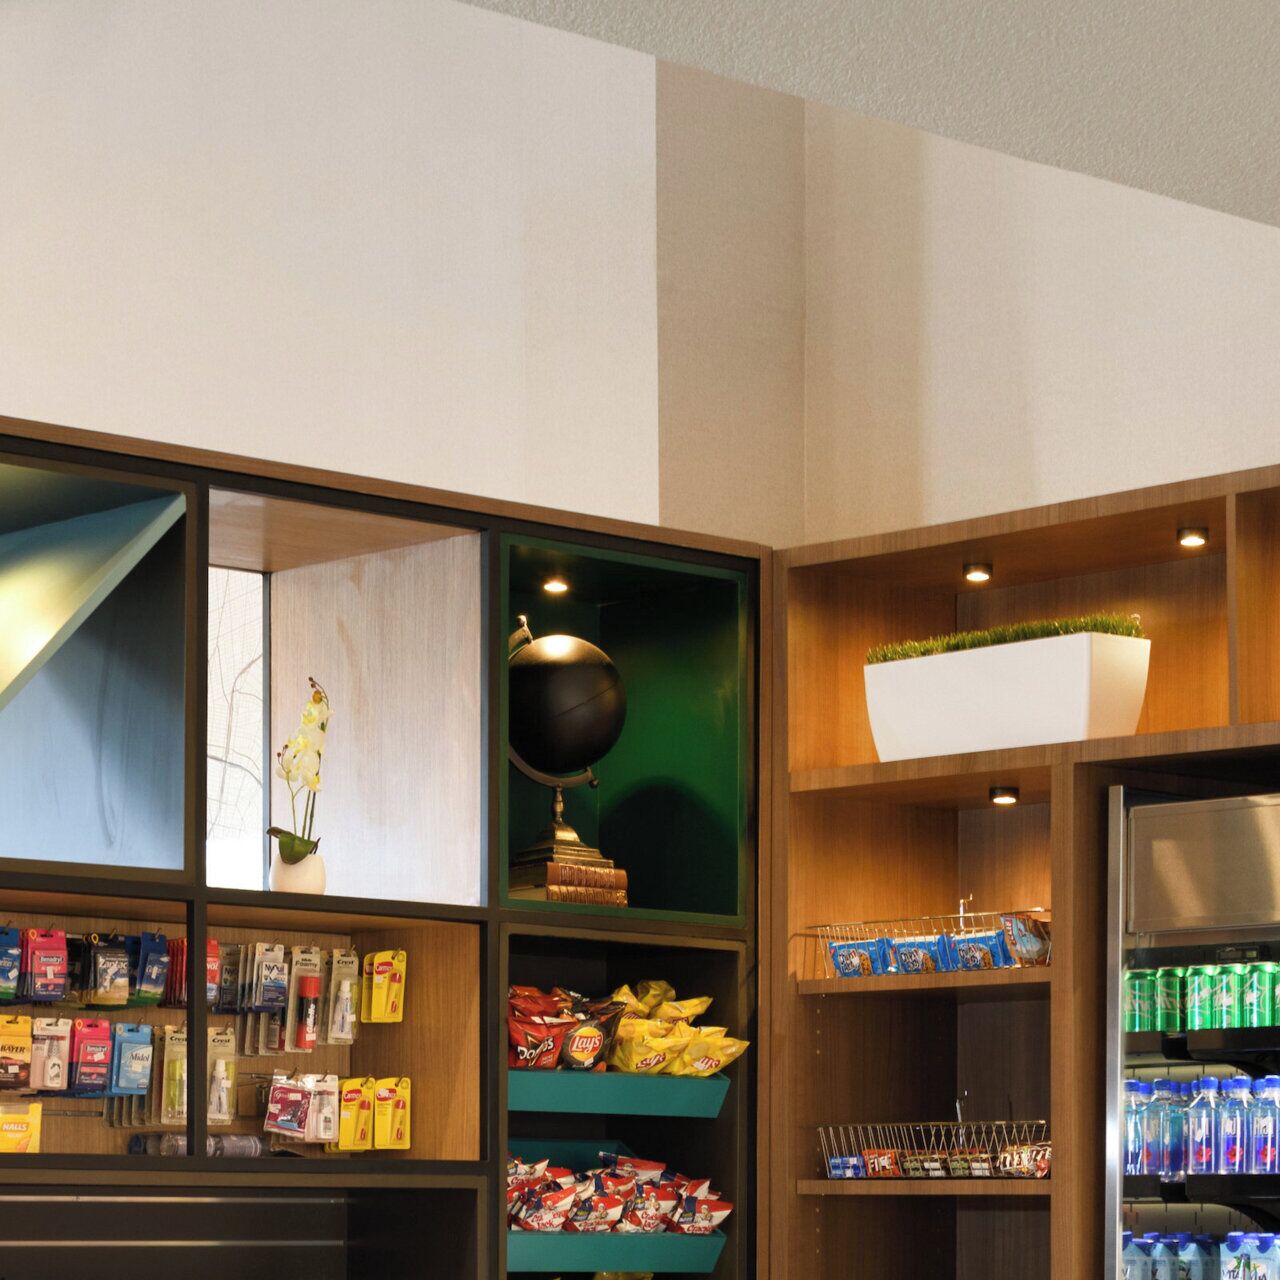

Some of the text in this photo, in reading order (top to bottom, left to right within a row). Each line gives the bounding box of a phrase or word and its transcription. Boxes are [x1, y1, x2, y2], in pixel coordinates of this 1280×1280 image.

[295, 961, 319, 969] Foamy
[336, 959, 355, 967] Crest
[571, 1034, 603, 1053] Lay's
[0, 1045, 26, 1054] BAYER
[129, 1052, 150, 1063] Midol
[2, 1123, 28, 1131] HALLS
